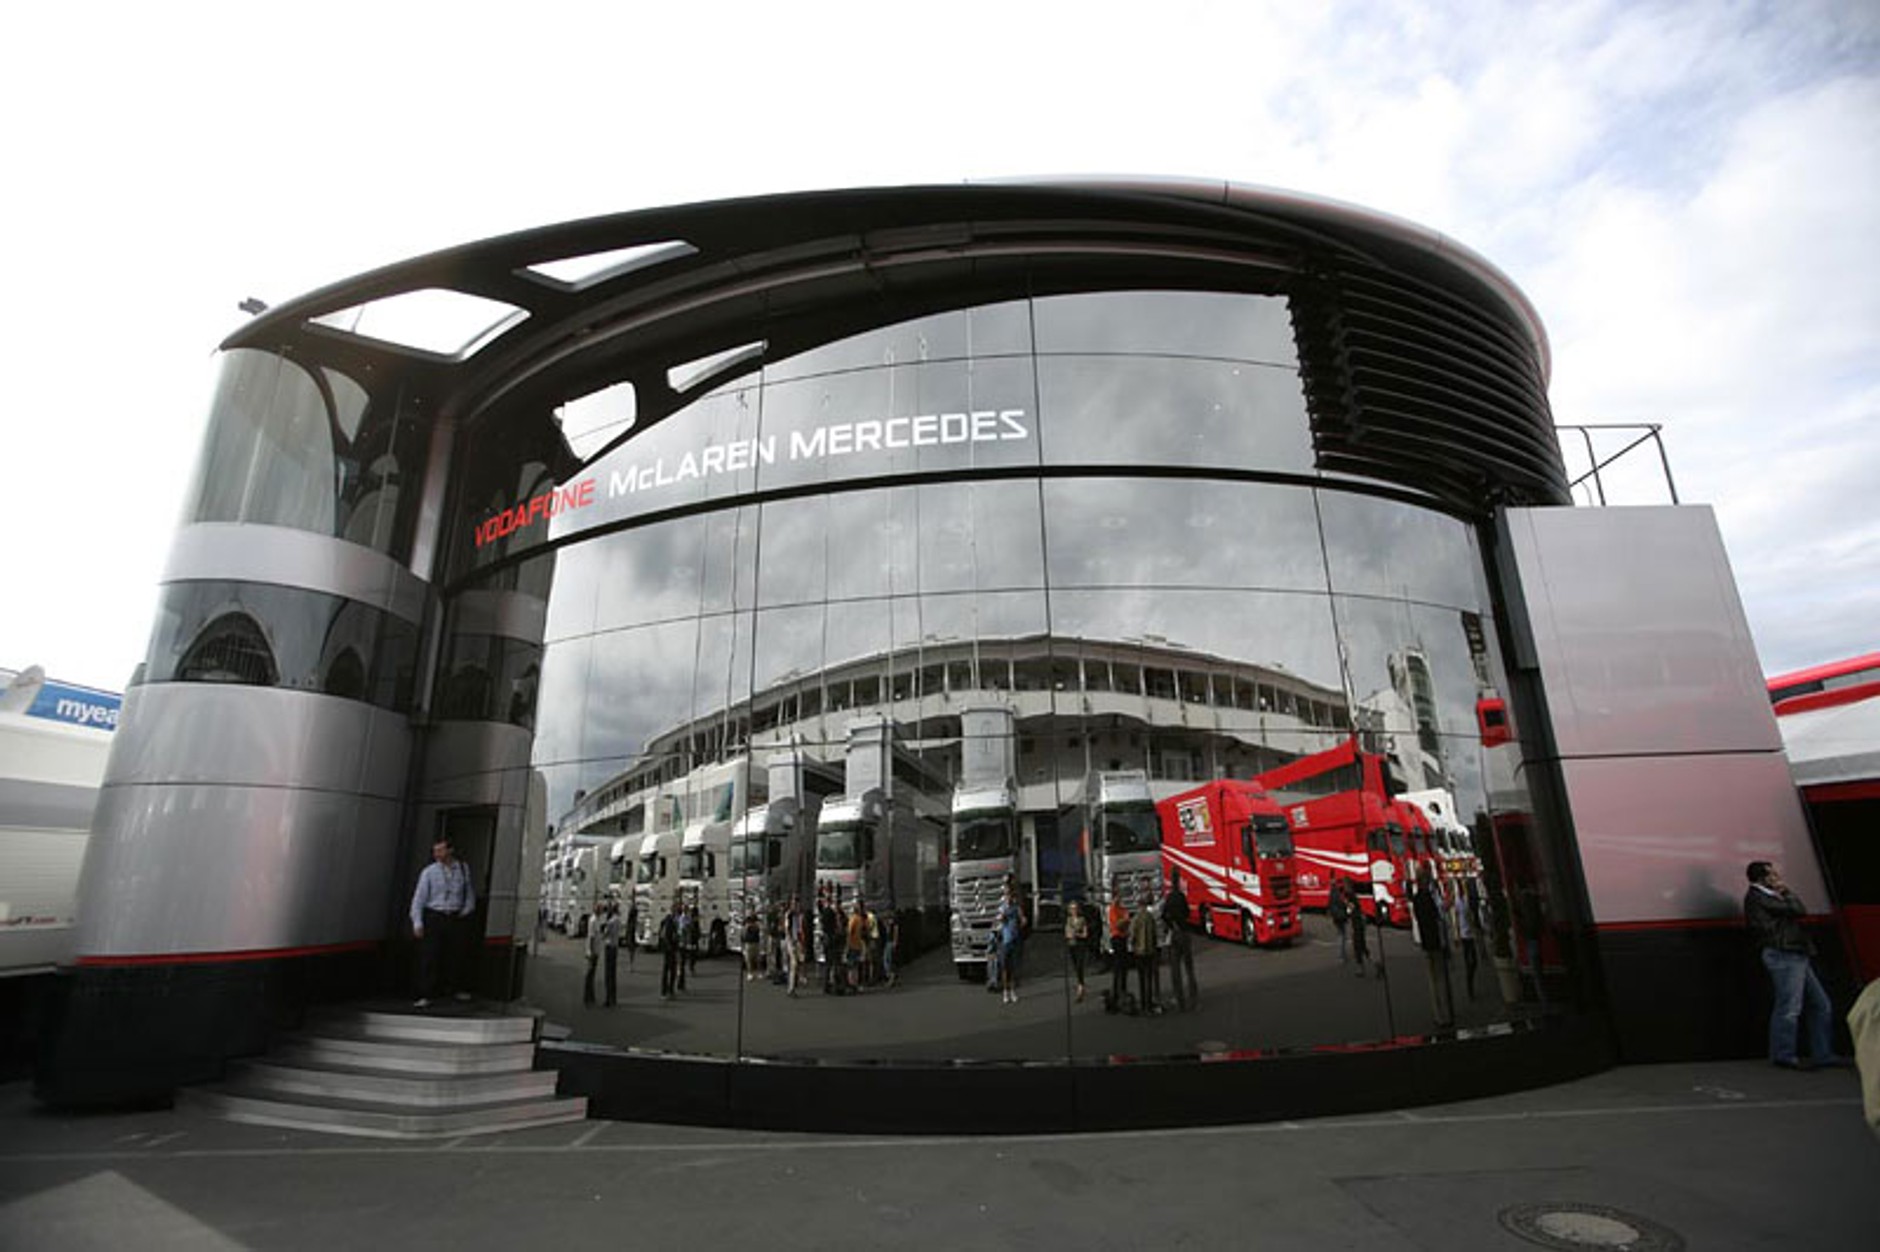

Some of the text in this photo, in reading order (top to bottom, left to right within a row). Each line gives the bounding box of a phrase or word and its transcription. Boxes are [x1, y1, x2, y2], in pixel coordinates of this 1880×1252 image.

[474, 409, 1029, 548] VODAFONE McLAREN MERCEDES
